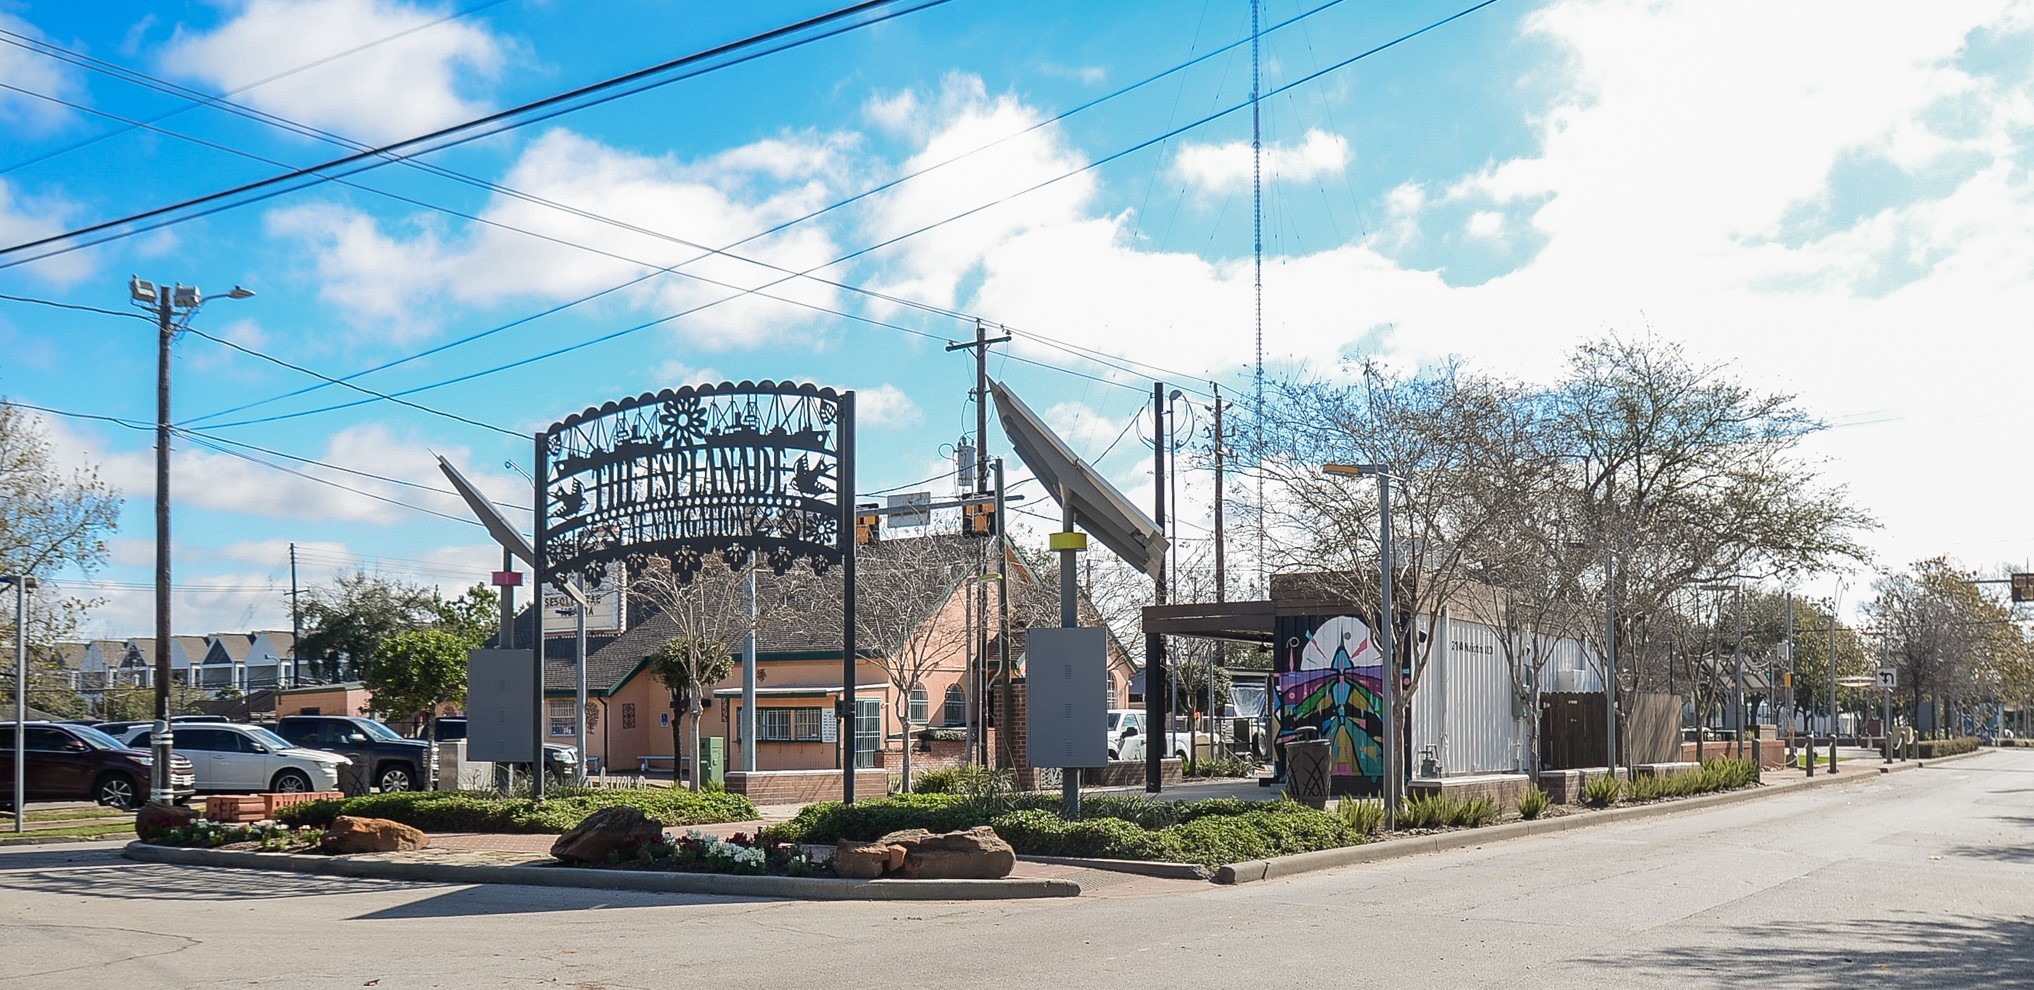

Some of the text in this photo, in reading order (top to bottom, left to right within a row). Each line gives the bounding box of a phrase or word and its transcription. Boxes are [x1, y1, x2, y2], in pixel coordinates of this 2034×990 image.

[592, 446, 787, 511] THE ESPLANADE
[651, 504, 747, 542] NAVIGATION
